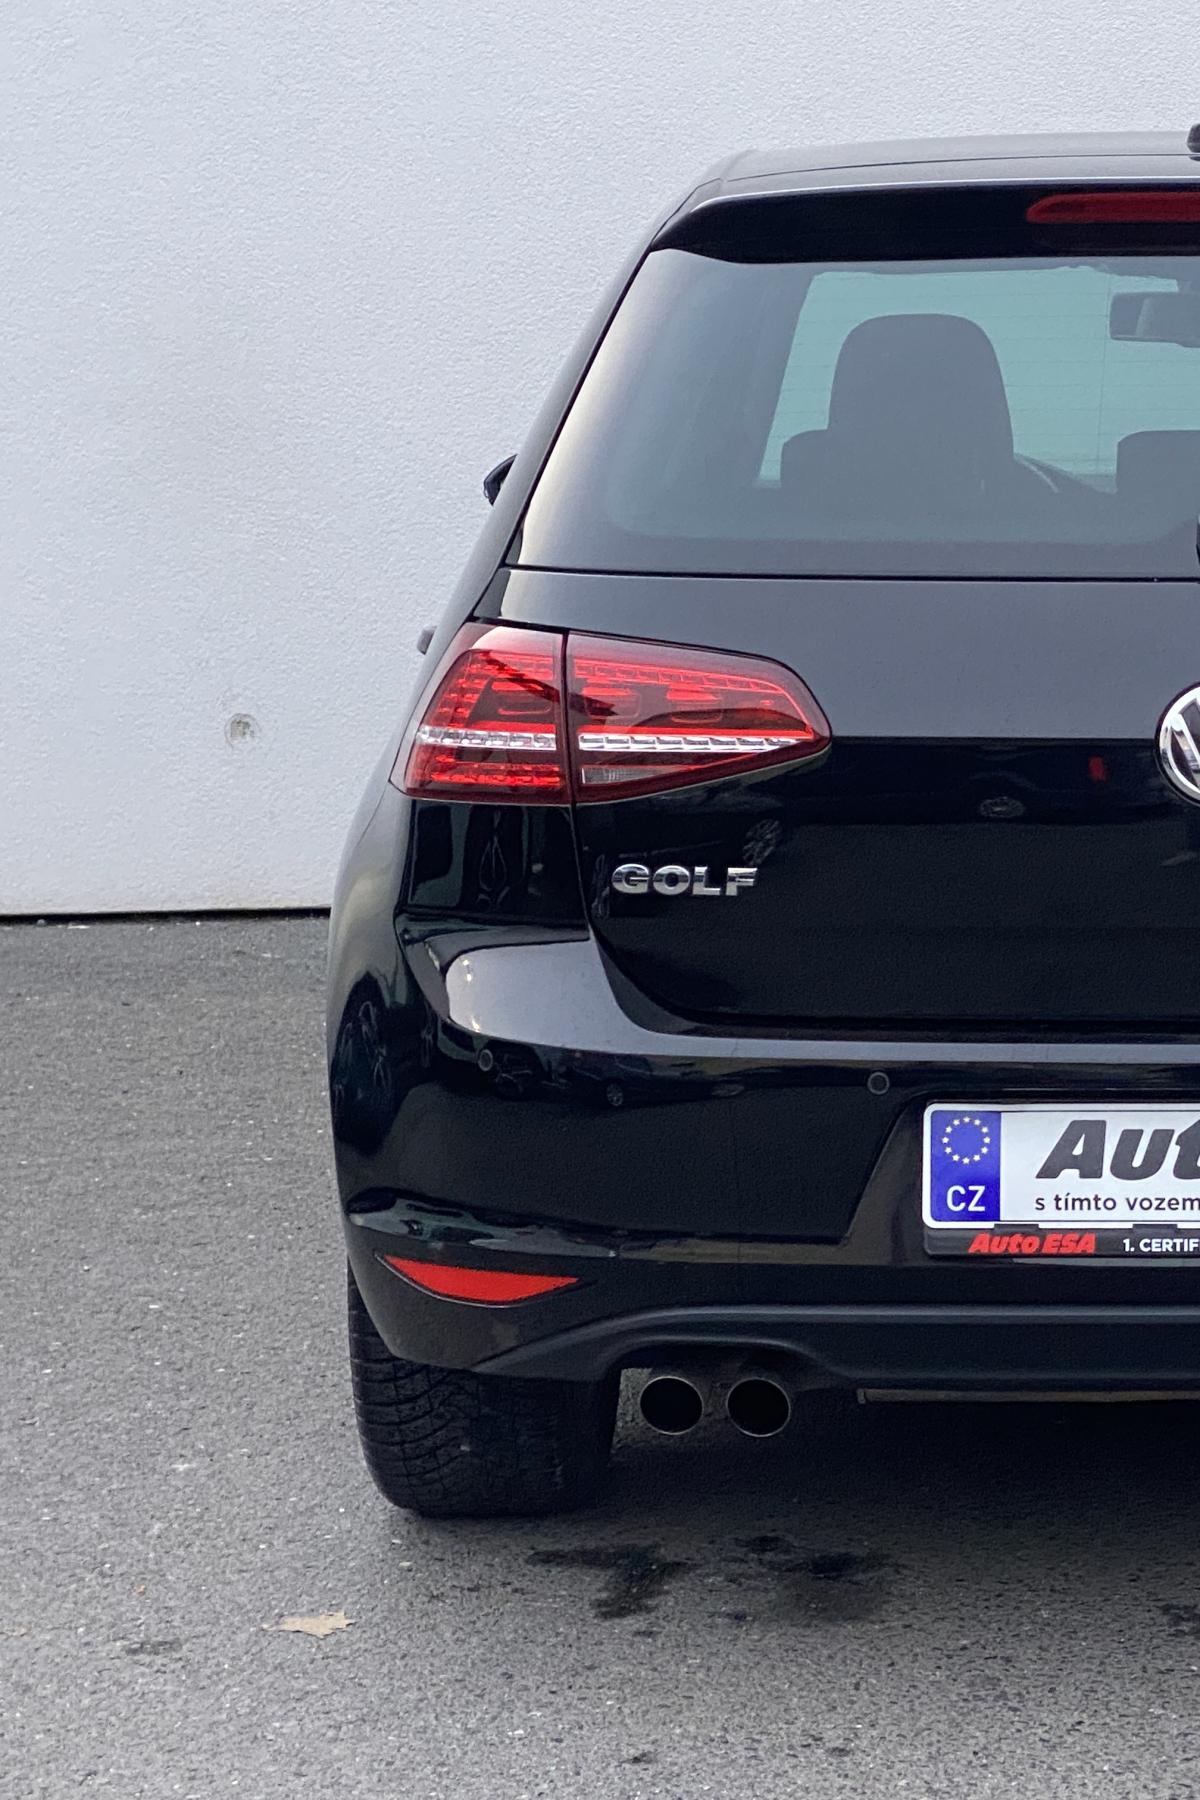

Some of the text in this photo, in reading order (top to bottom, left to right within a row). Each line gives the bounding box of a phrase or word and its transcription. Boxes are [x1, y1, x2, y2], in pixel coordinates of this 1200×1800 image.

[611, 863, 758, 896] GOLF
[946, 1185, 986, 1212] CZ
[1035, 1197, 1045, 1211] s
[1054, 1191, 1116, 1211] tímto
[967, 1233, 1096, 1254] Auto ESA
[1122, 1238, 1135, 1252] 1.
